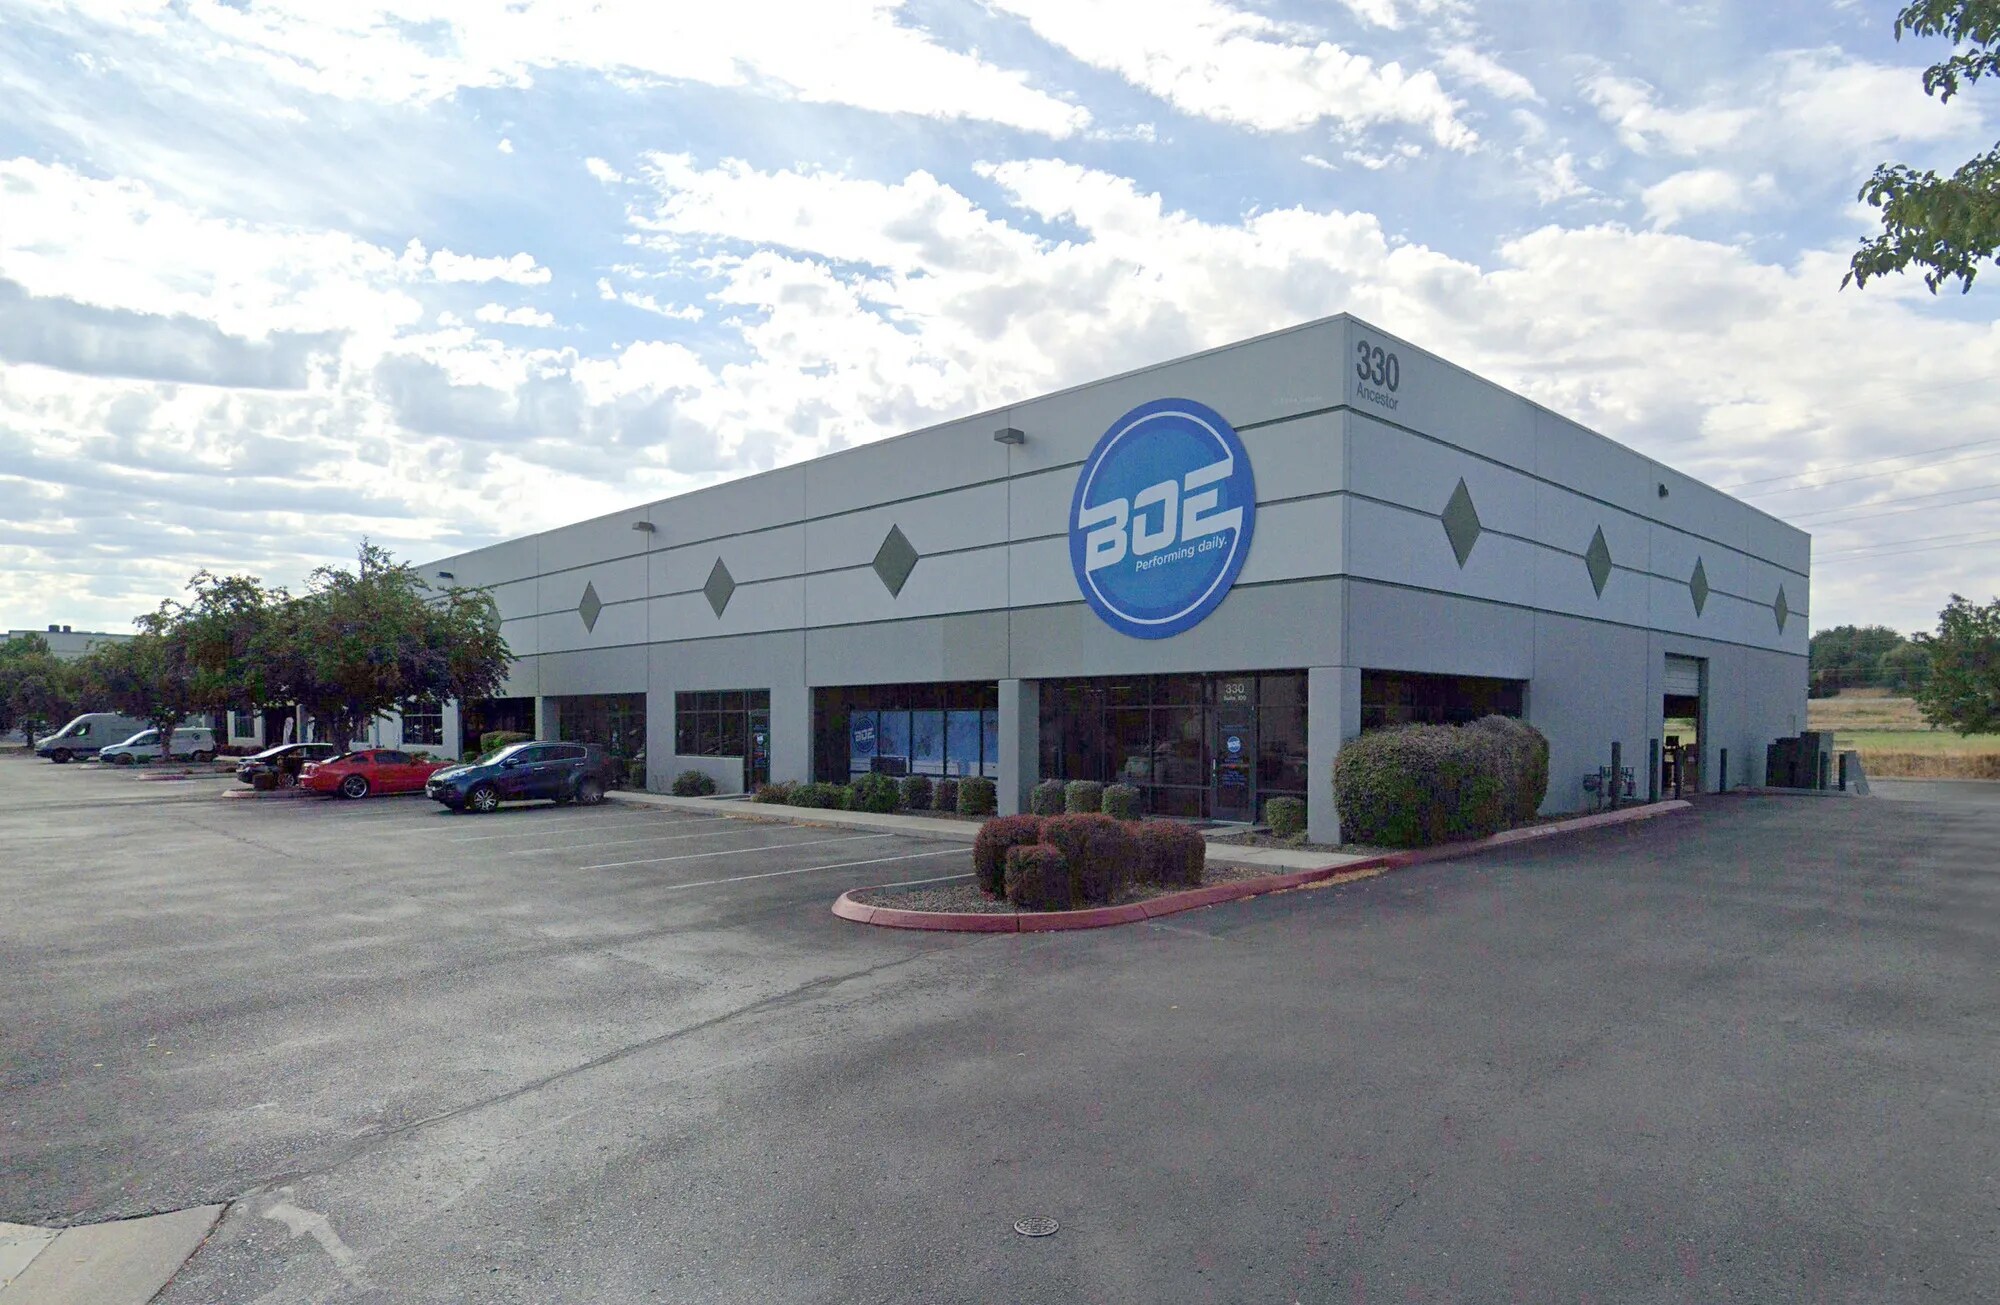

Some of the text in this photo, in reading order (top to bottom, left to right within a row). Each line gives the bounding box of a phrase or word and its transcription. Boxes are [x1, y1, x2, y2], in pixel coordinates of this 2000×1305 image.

[1357, 340, 1399, 393] 330
[1357, 382, 1399, 411] Ancestor
[1078, 457, 1243, 571] BOE
[1135, 536, 1227, 572] Performing daily.
[1225, 684, 1245, 694] 330
